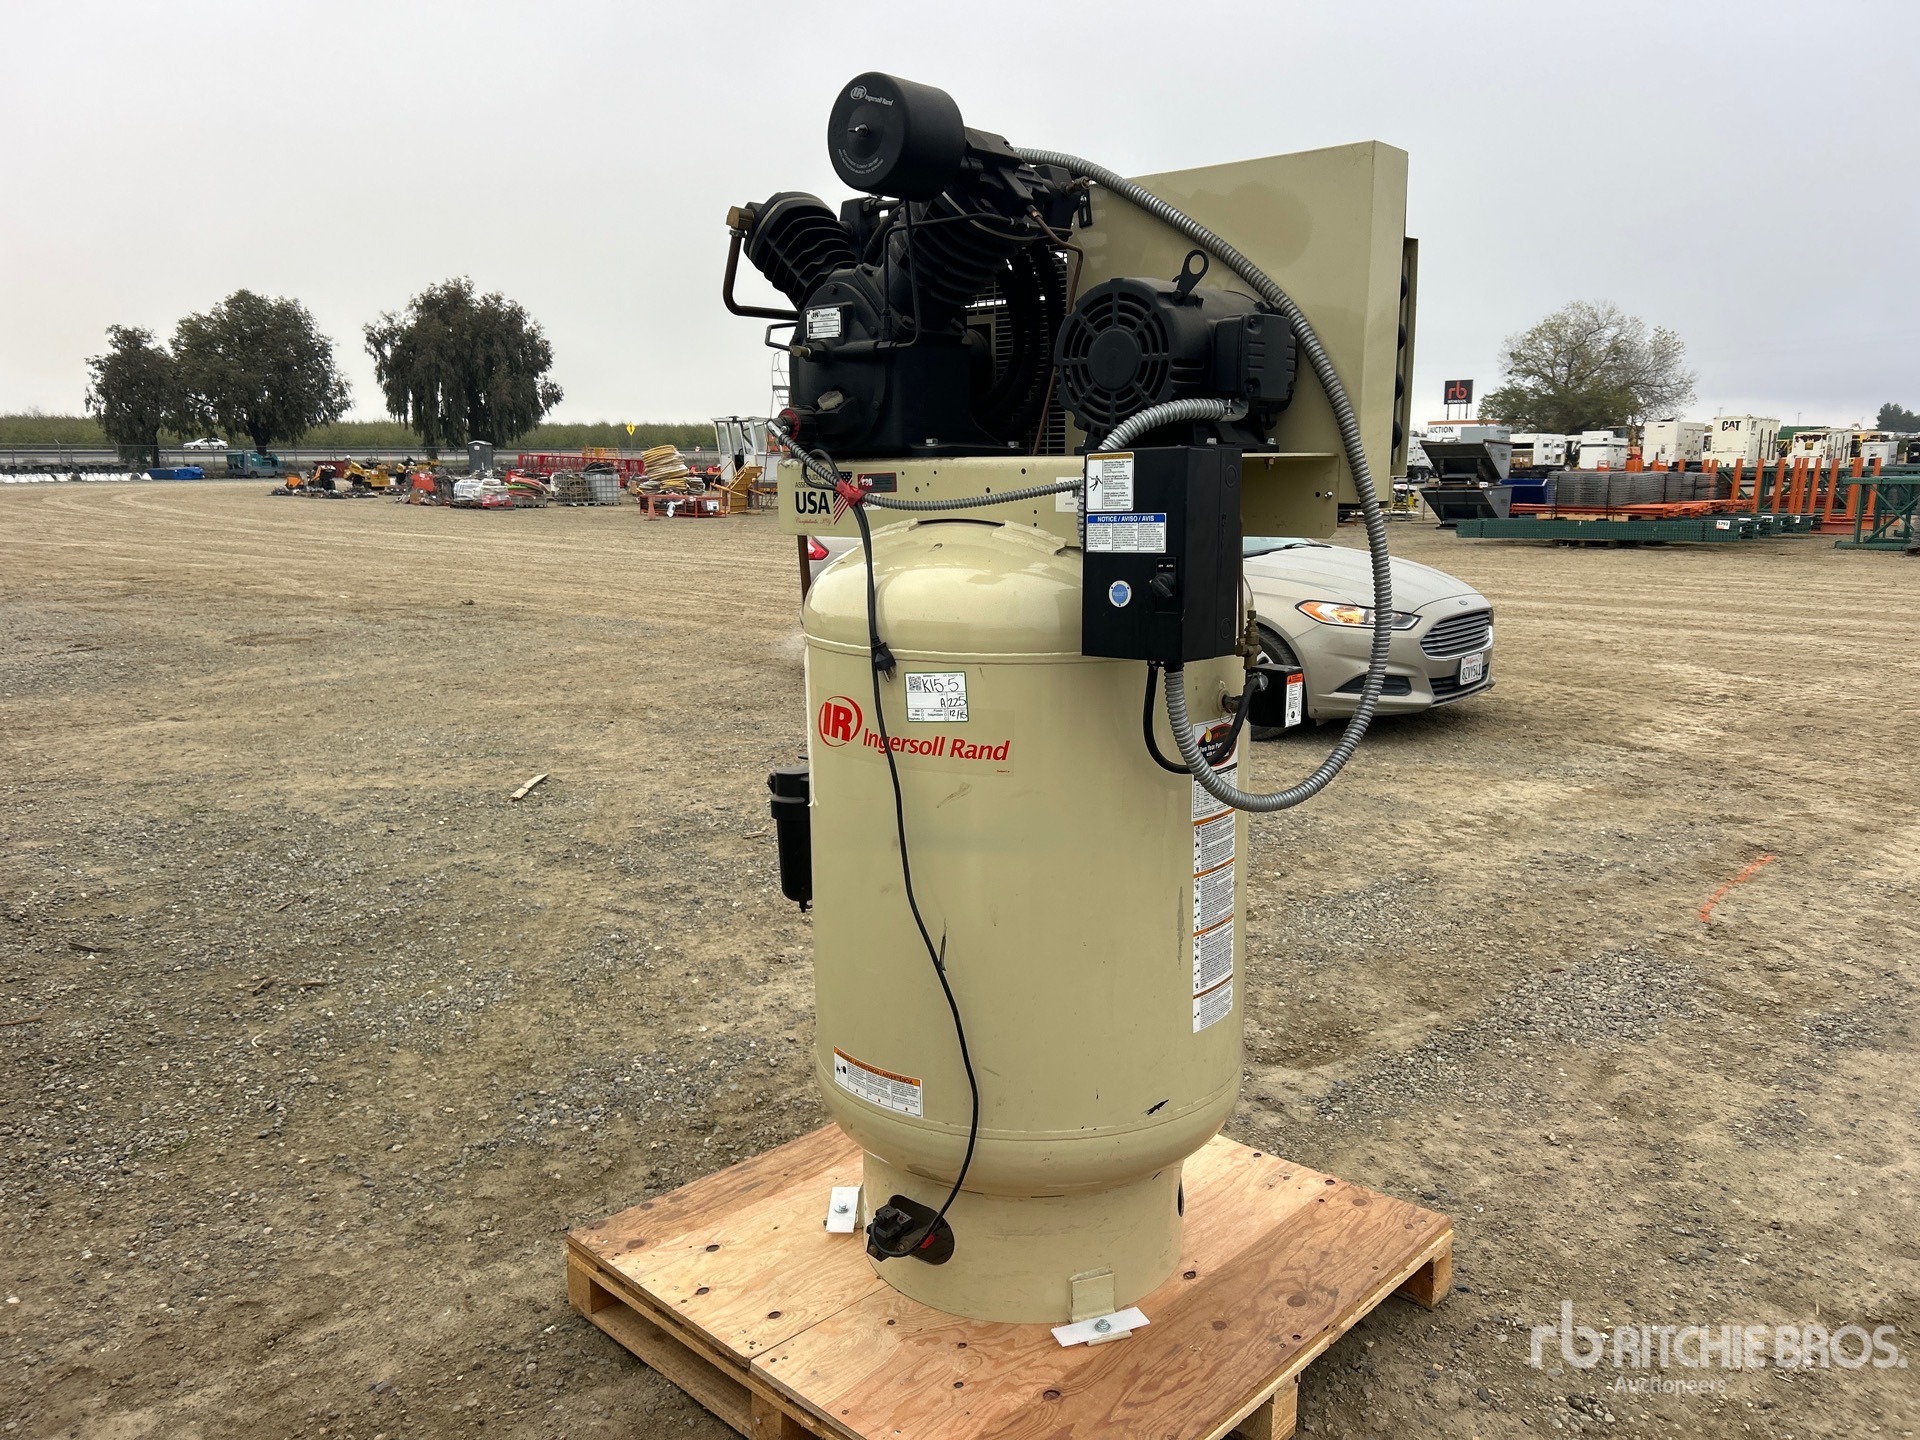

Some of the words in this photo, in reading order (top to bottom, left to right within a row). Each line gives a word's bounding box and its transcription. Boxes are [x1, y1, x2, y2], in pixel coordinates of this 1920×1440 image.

[1448, 380, 1467, 399] rb
[1722, 421, 1741, 431] CAT
[795, 491, 831, 514] USA
[950, 738, 1010, 761] Rand
